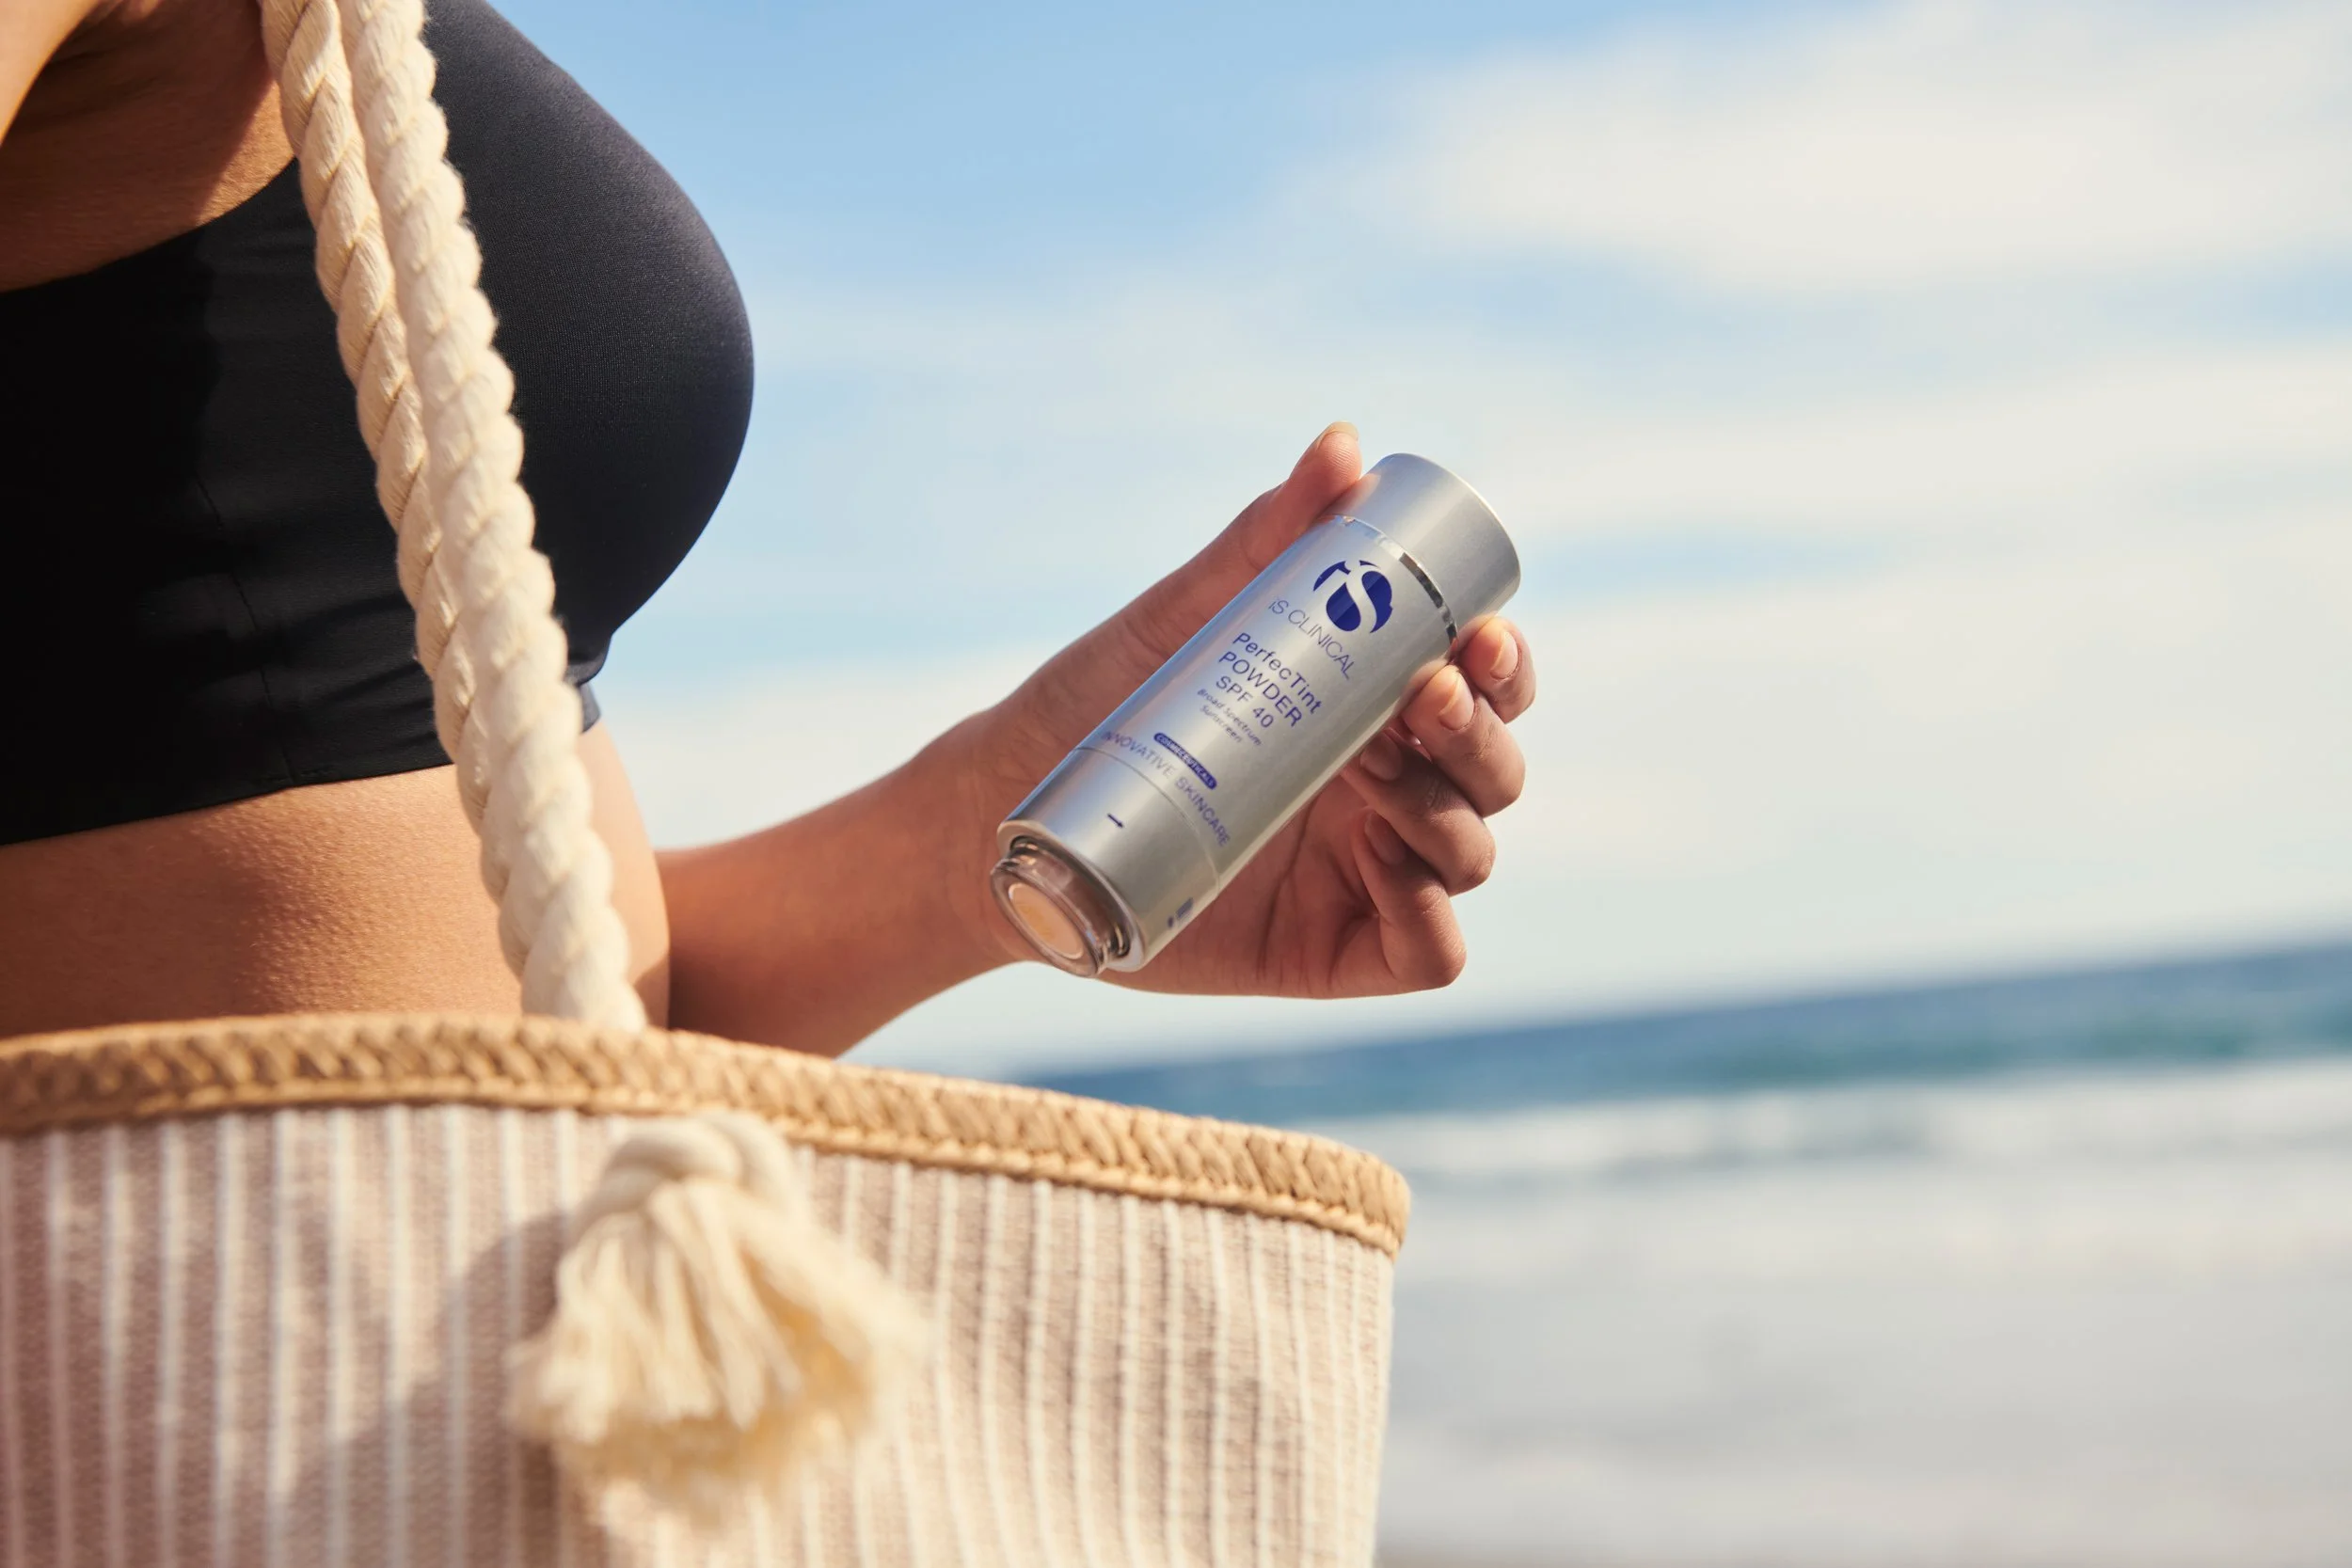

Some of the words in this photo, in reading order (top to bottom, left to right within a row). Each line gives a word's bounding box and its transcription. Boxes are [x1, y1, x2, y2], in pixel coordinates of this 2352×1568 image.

[1232, 632, 1322, 714] PerfecTint
[1268, 598, 1289, 614] iS
[1288, 610, 1354, 680] CLINICAL
[1216, 676, 1253, 702] SPF
[1252, 707, 1274, 728] 40
[1218, 651, 1302, 727] POWDER
[1175, 776, 1231, 847] SKINCARE
